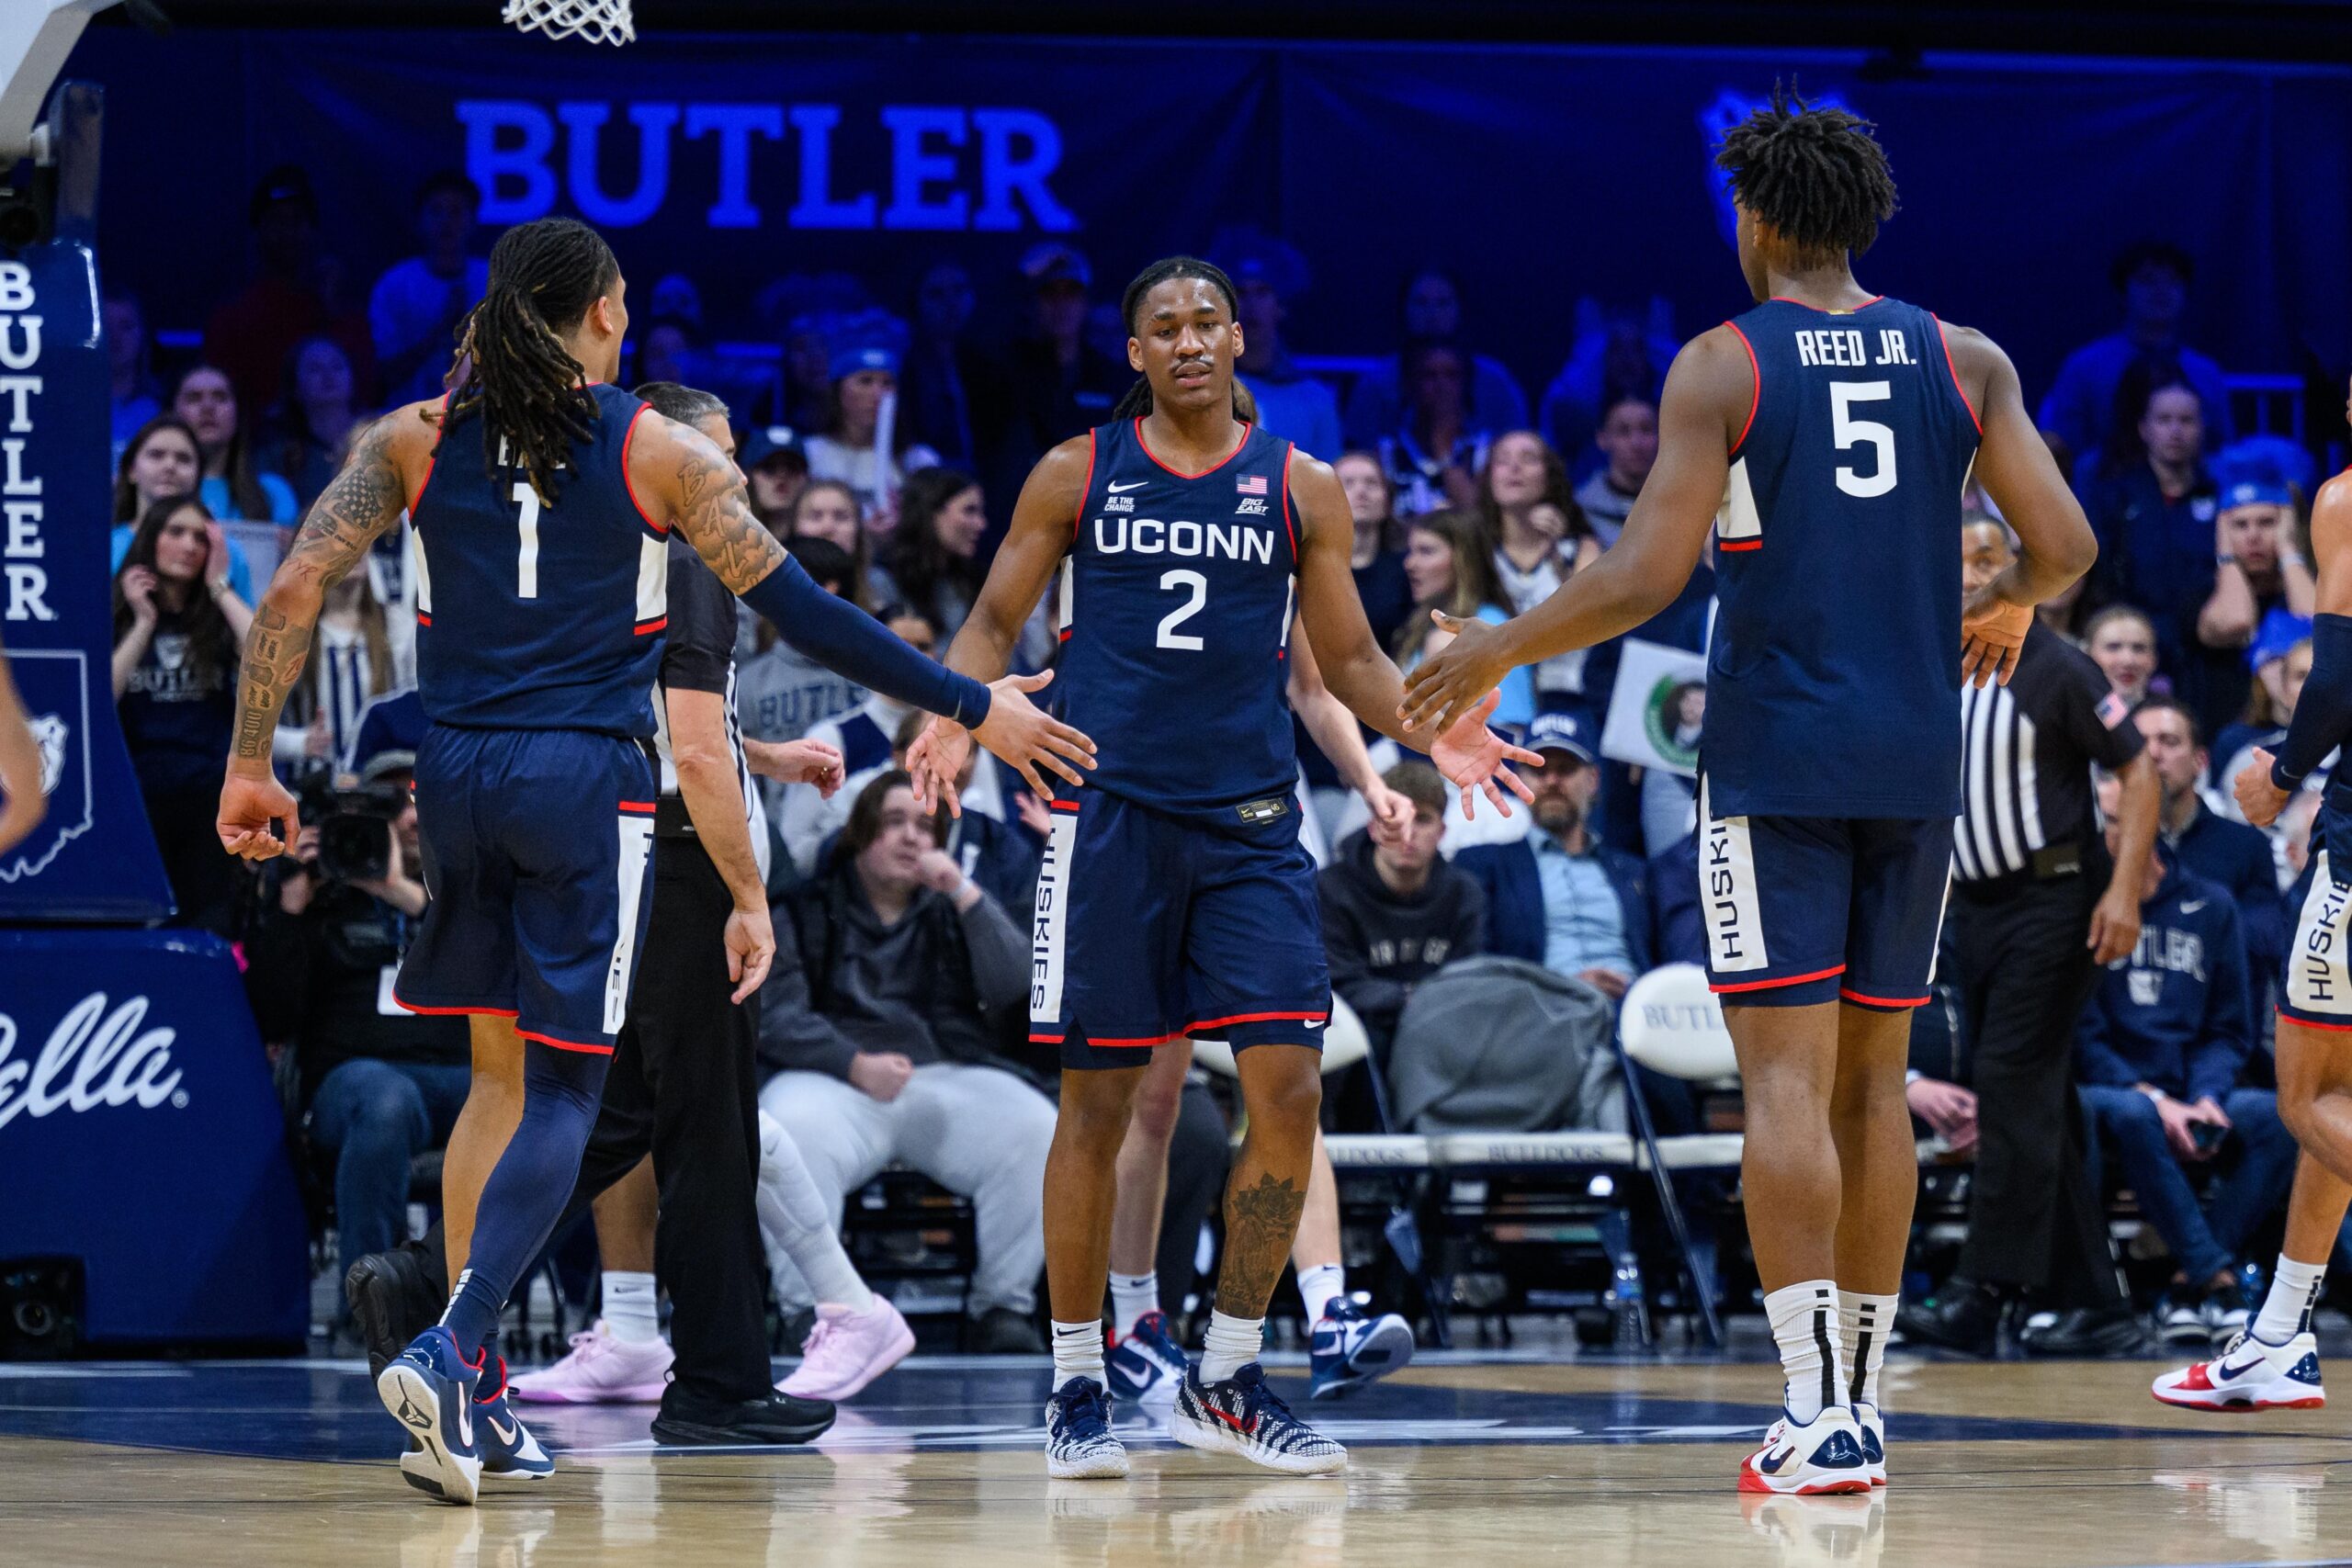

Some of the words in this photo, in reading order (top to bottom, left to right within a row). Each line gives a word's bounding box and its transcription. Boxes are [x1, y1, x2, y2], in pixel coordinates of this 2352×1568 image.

[455, 99, 1081, 232] BUTLER
[1795, 330, 1866, 367] REED
[1875, 330, 1917, 365] JR.
[0, 261, 55, 621] BUTLER
[1829, 380, 1897, 498] 5
[1104, 504, 1136, 513] CHANGE
[1107, 496, 1119, 504] BE
[1120, 497, 1134, 505] THE
[1238, 504, 1269, 513] EAST
[1241, 498, 1264, 506] BIG
[512, 482, 540, 598] 1
[1094, 518, 1274, 565] UCONN
[1156, 569, 1207, 651] 2
[0, 991, 183, 1129] ella
